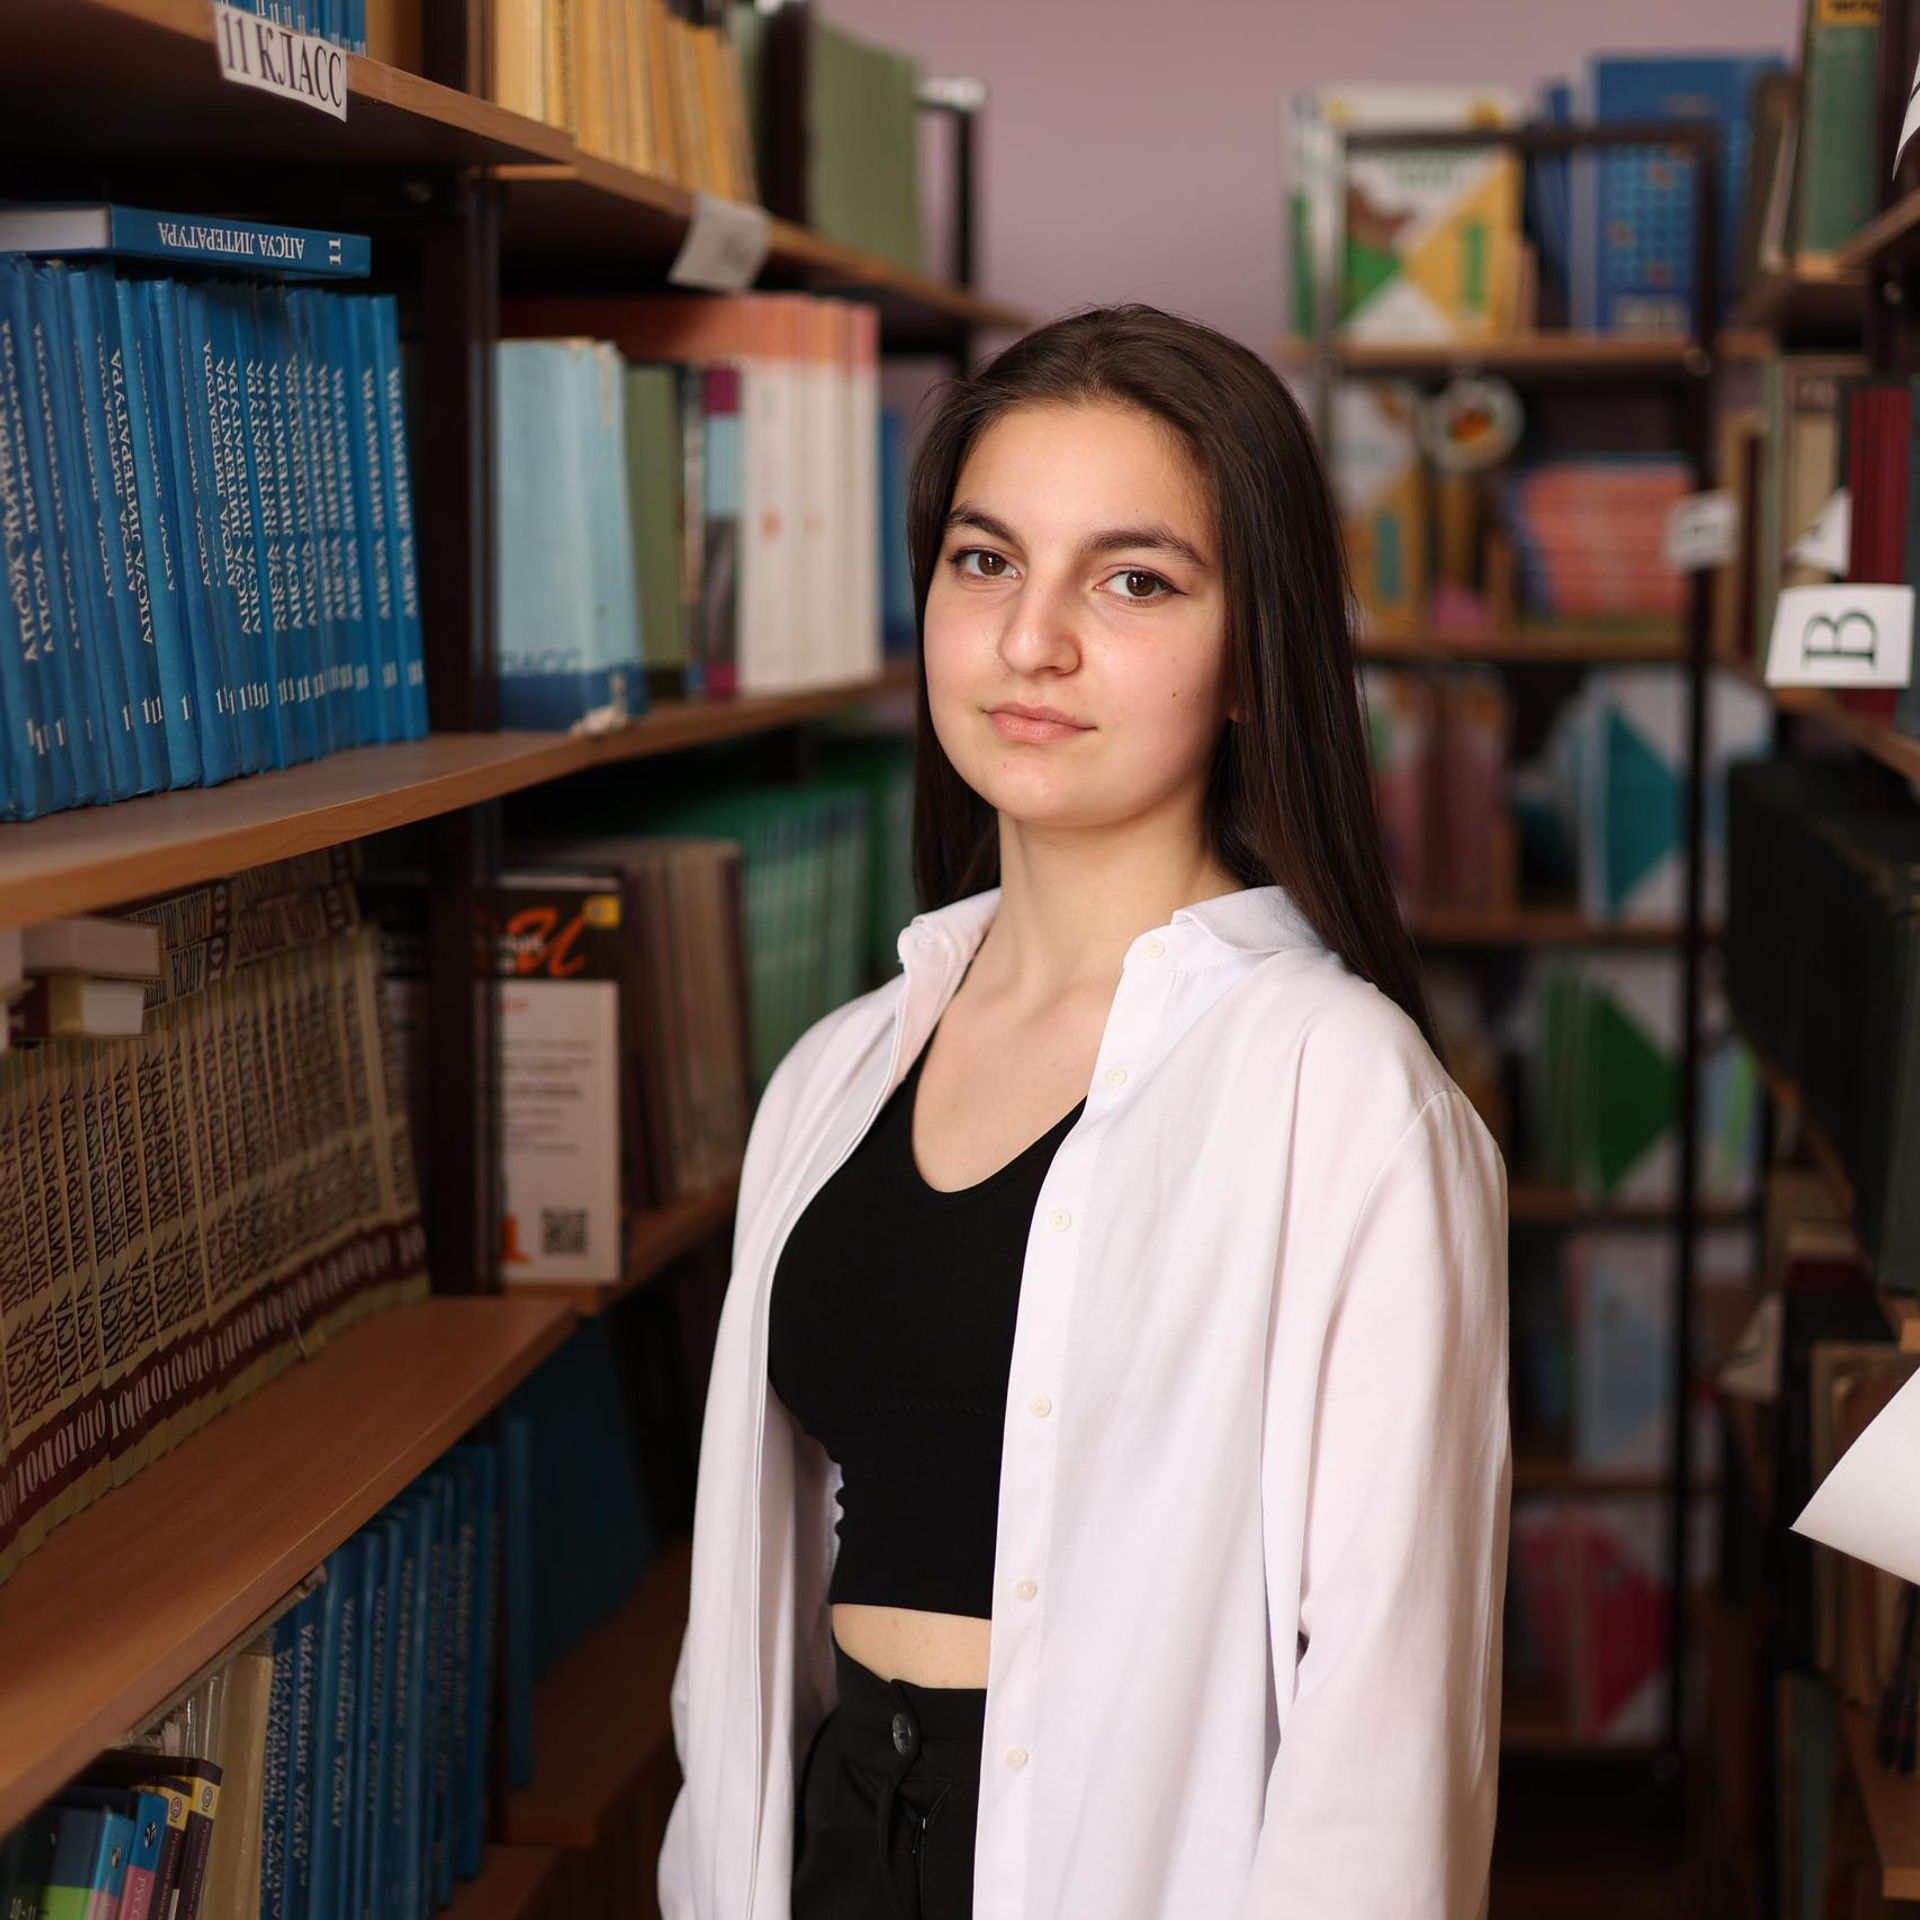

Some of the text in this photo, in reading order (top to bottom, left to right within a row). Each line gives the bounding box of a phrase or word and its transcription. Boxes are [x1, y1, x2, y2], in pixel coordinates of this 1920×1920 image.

[221, 11, 342, 108] 11 КЛАСС
[157, 222, 255, 256] ЛИТЕРАТУРА
[110, 347, 142, 542] ЛИТЕРАТУРА
[203, 339, 227, 499] ЛИТЕРАТУРА
[215, 357, 241, 539] ЛИТЕРАТУРА
[228, 359, 253, 540] ЛИТЕРАТУРА
[269, 362, 294, 538] ЛИТЕРАТУРА
[37, 1089, 80, 1390] АПСУА ЛИТЕРАТУРА
[59, 1082, 99, 1377] АПСУА ЛИТЕРАТУРА
[83, 1080, 122, 1369] АПСУА ЛИТЕРАТУРА
[115, 1057, 156, 1343] АПСУА ЛИТЕРАТУРА
